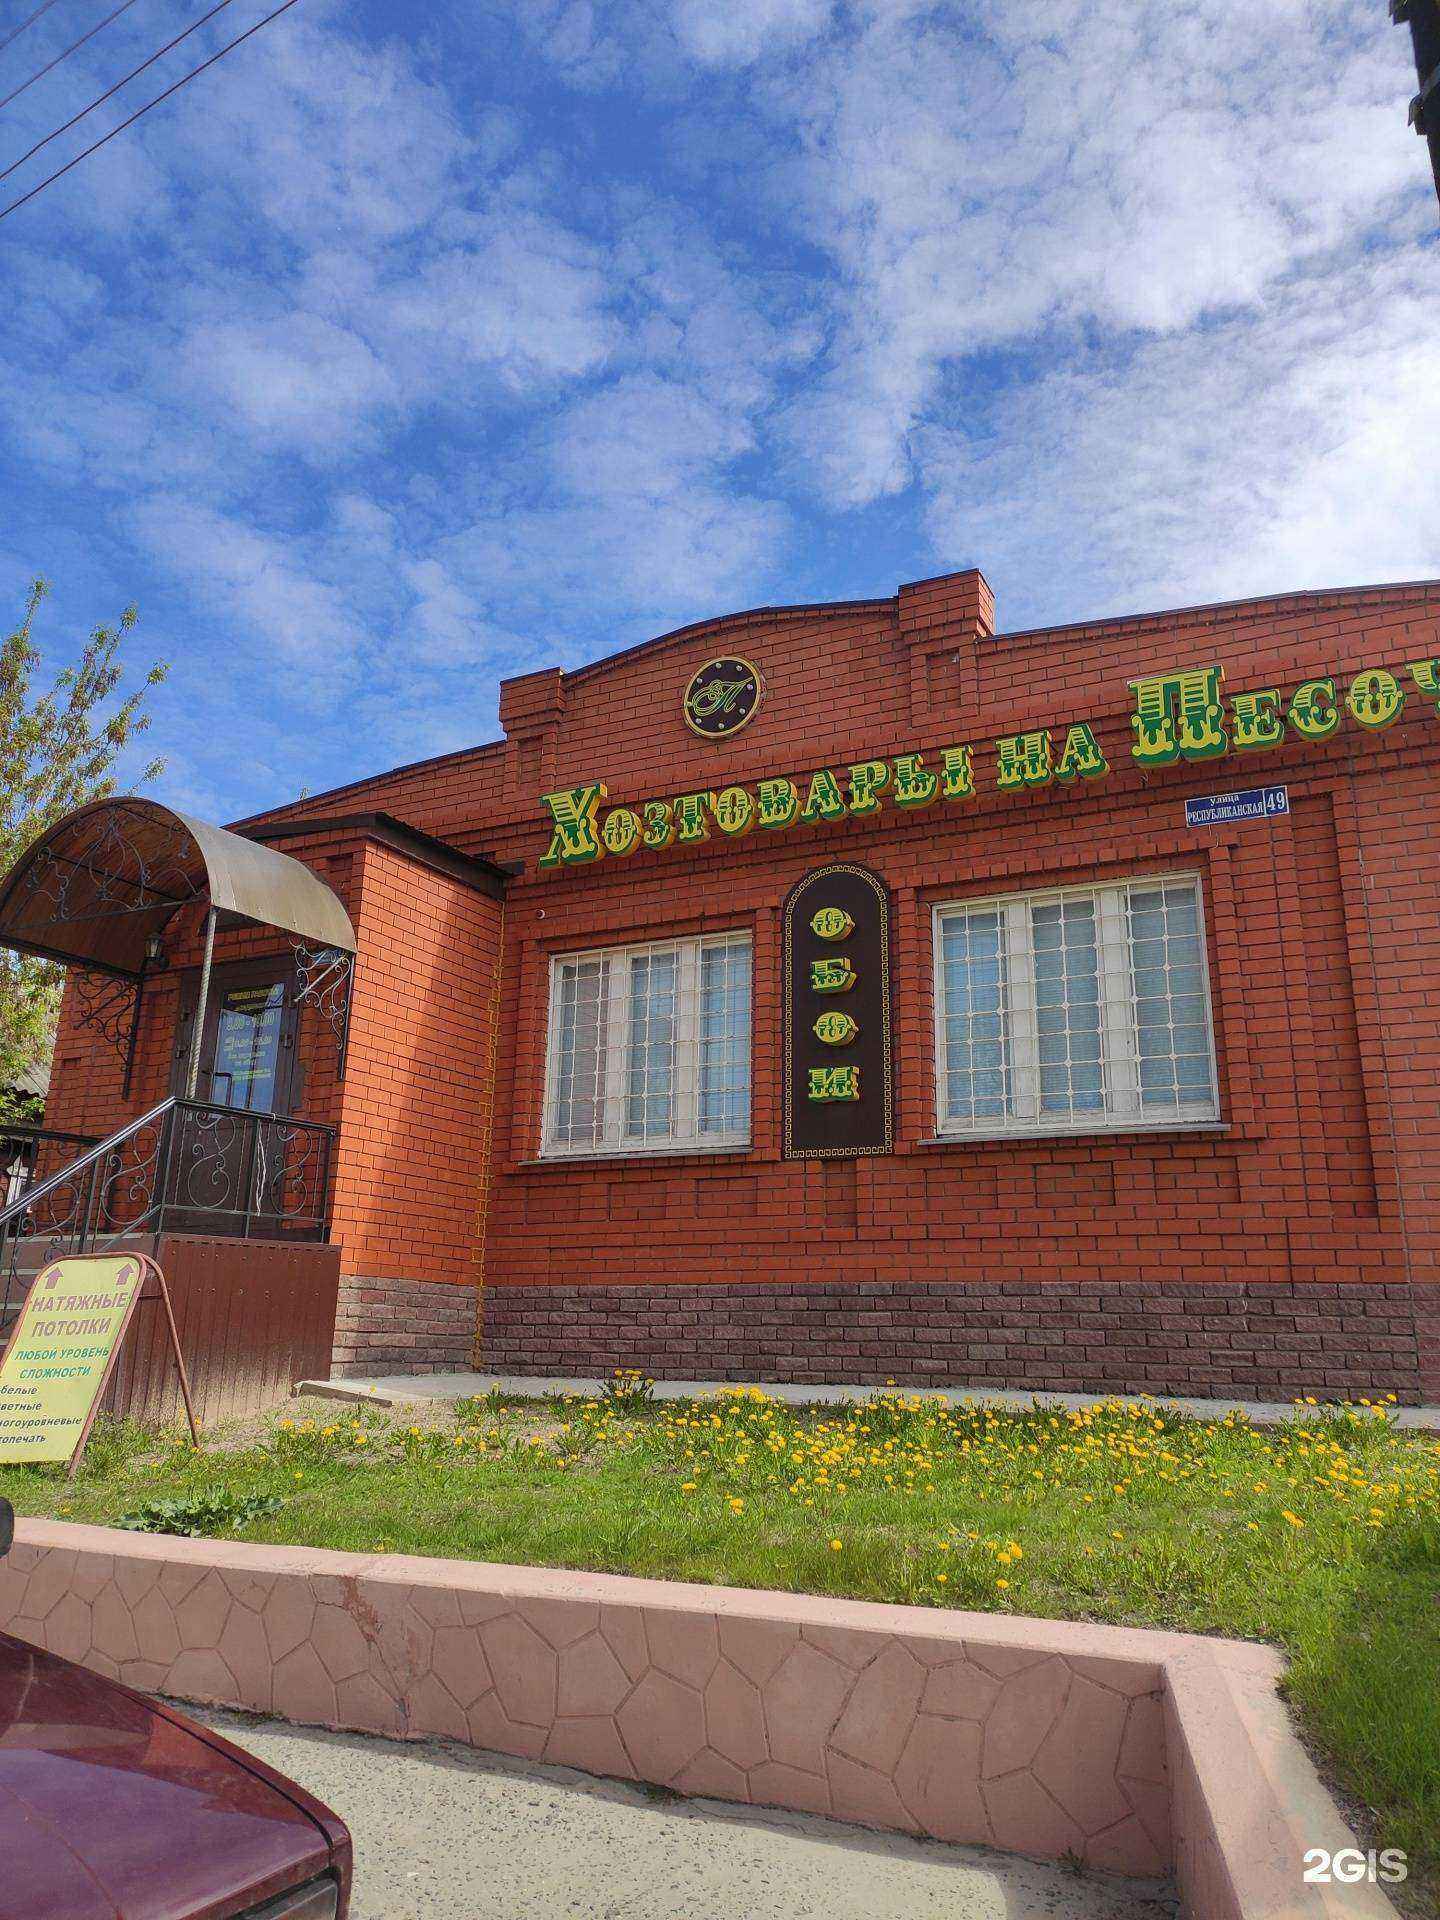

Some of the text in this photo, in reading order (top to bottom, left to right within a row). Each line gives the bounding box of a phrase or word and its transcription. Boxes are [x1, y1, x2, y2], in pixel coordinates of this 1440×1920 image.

[996, 723, 1111, 793] НА
[1209, 794, 1239, 806] улица
[1267, 791, 1285, 811] 49
[1187, 801, 1264, 822] РЕСПУБЛИКАНСКАЯ
[808, 907, 859, 1102] ОБОИ
[31, 1292, 129, 1312] НАТЯЖНЫЕ
[31, 1317, 112, 1337] ПОТОЛКИ
[15, 1346, 110, 1361] ЛЮБОЙ УРОВЕНЬ
[19, 1366, 91, 1379] СЛОЖНОСТИ
[0, 1401, 42, 1411] ветные
